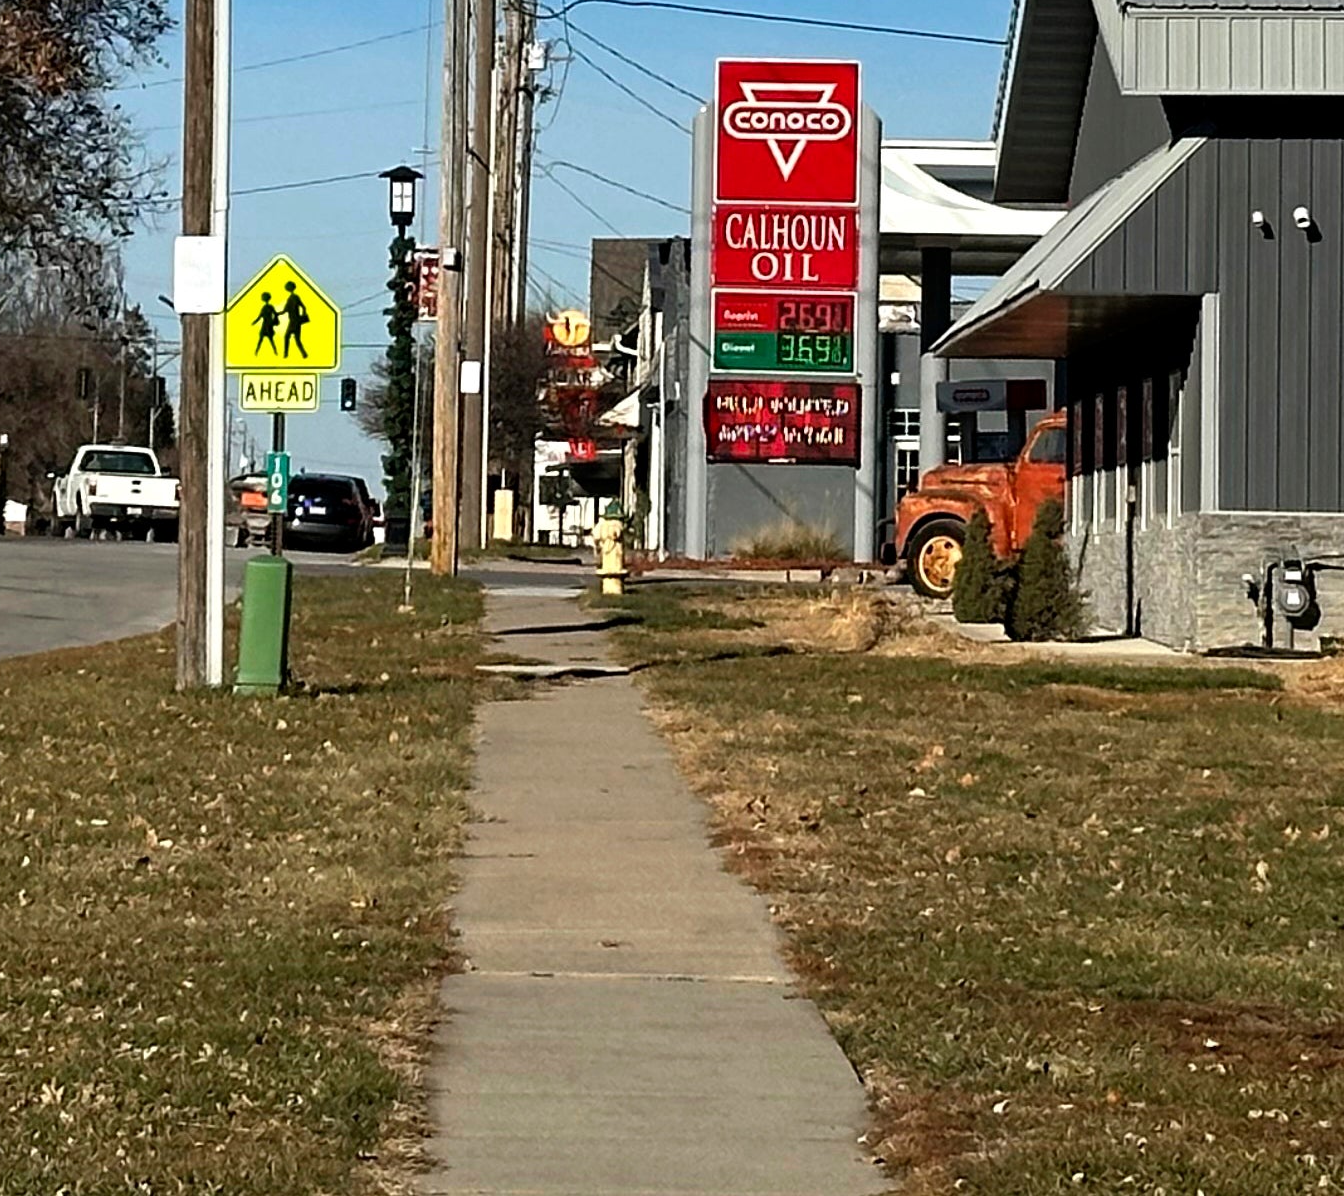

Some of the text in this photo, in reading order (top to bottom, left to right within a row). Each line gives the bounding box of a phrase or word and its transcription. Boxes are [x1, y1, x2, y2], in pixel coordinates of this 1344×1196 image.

[725, 213, 846, 251] CALHOUN
[751, 252, 819, 282] OIL
[245, 381, 314, 402] AHEAD
